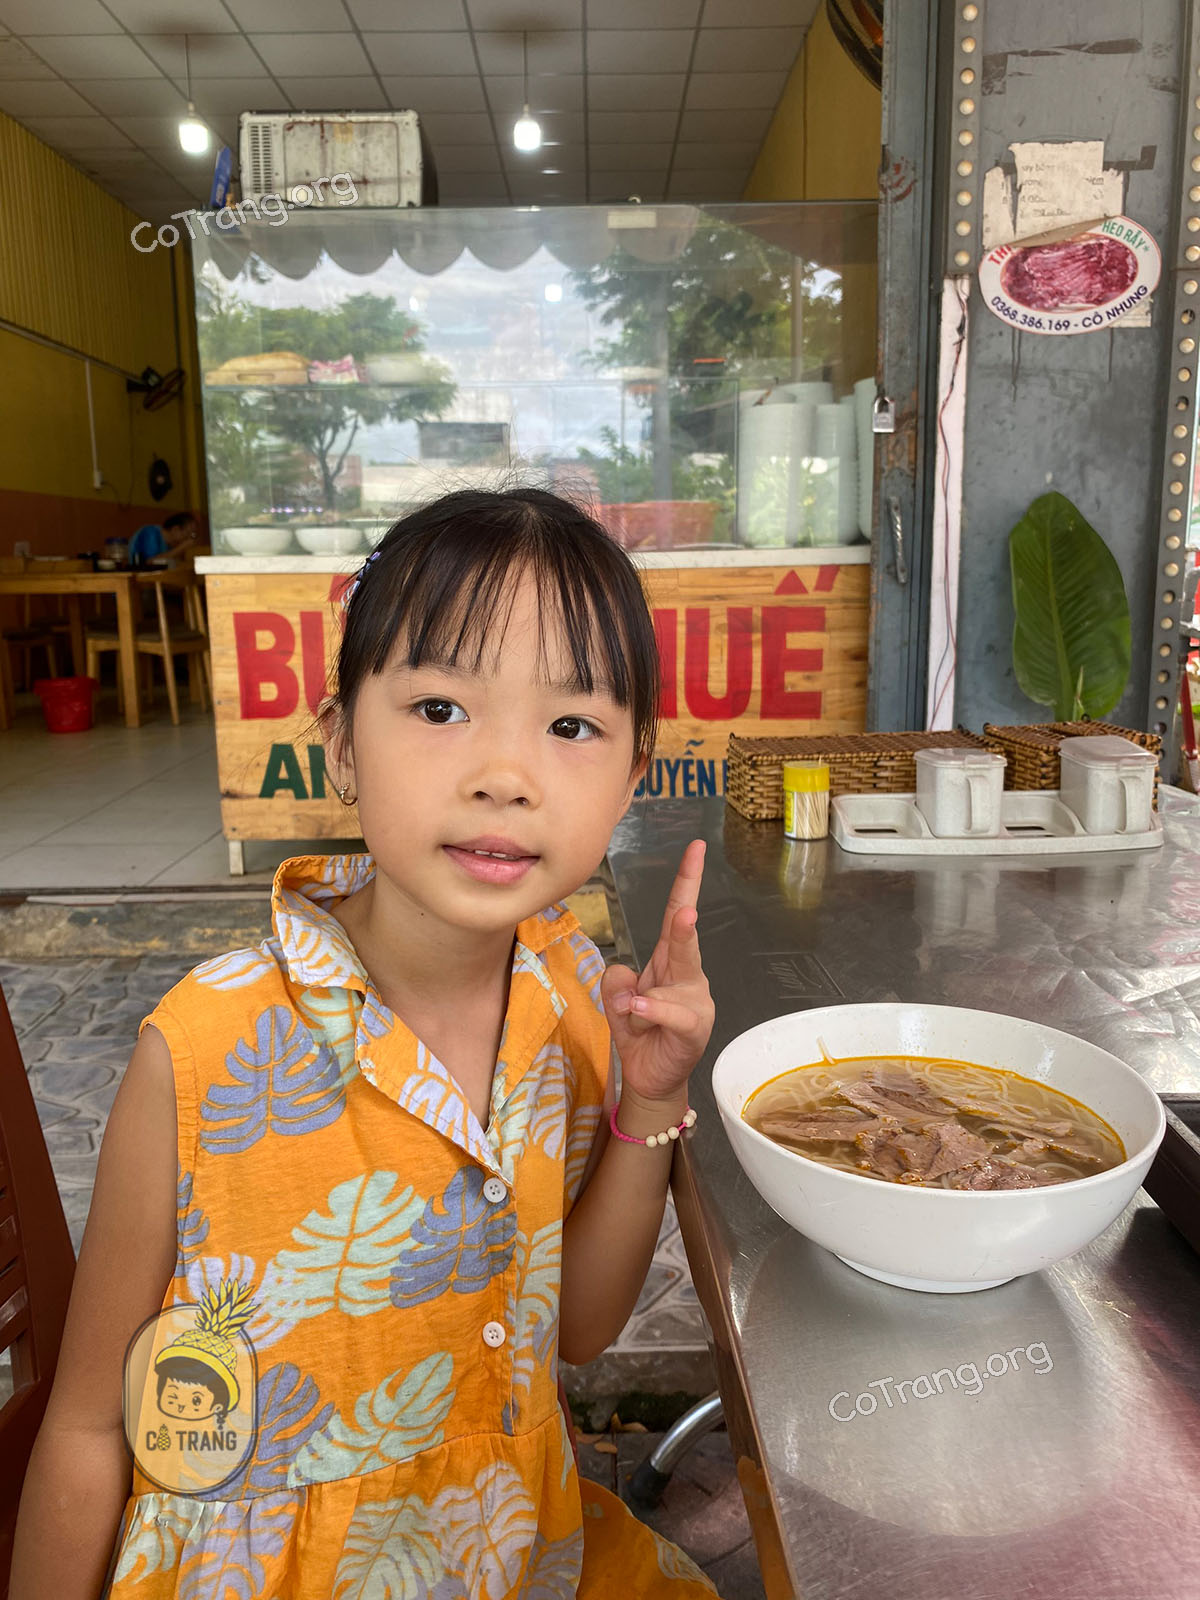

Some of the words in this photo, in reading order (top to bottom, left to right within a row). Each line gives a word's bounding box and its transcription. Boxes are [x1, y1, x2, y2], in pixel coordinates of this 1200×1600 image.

[1102, 219, 1123, 237] HEO
[991, 296, 1070, 331] 0368.386.169
[1082, 312, 1103, 329] CÔ
[1106, 284, 1148, 321] NHUNG
[634, 739, 717, 798] UYỄN
